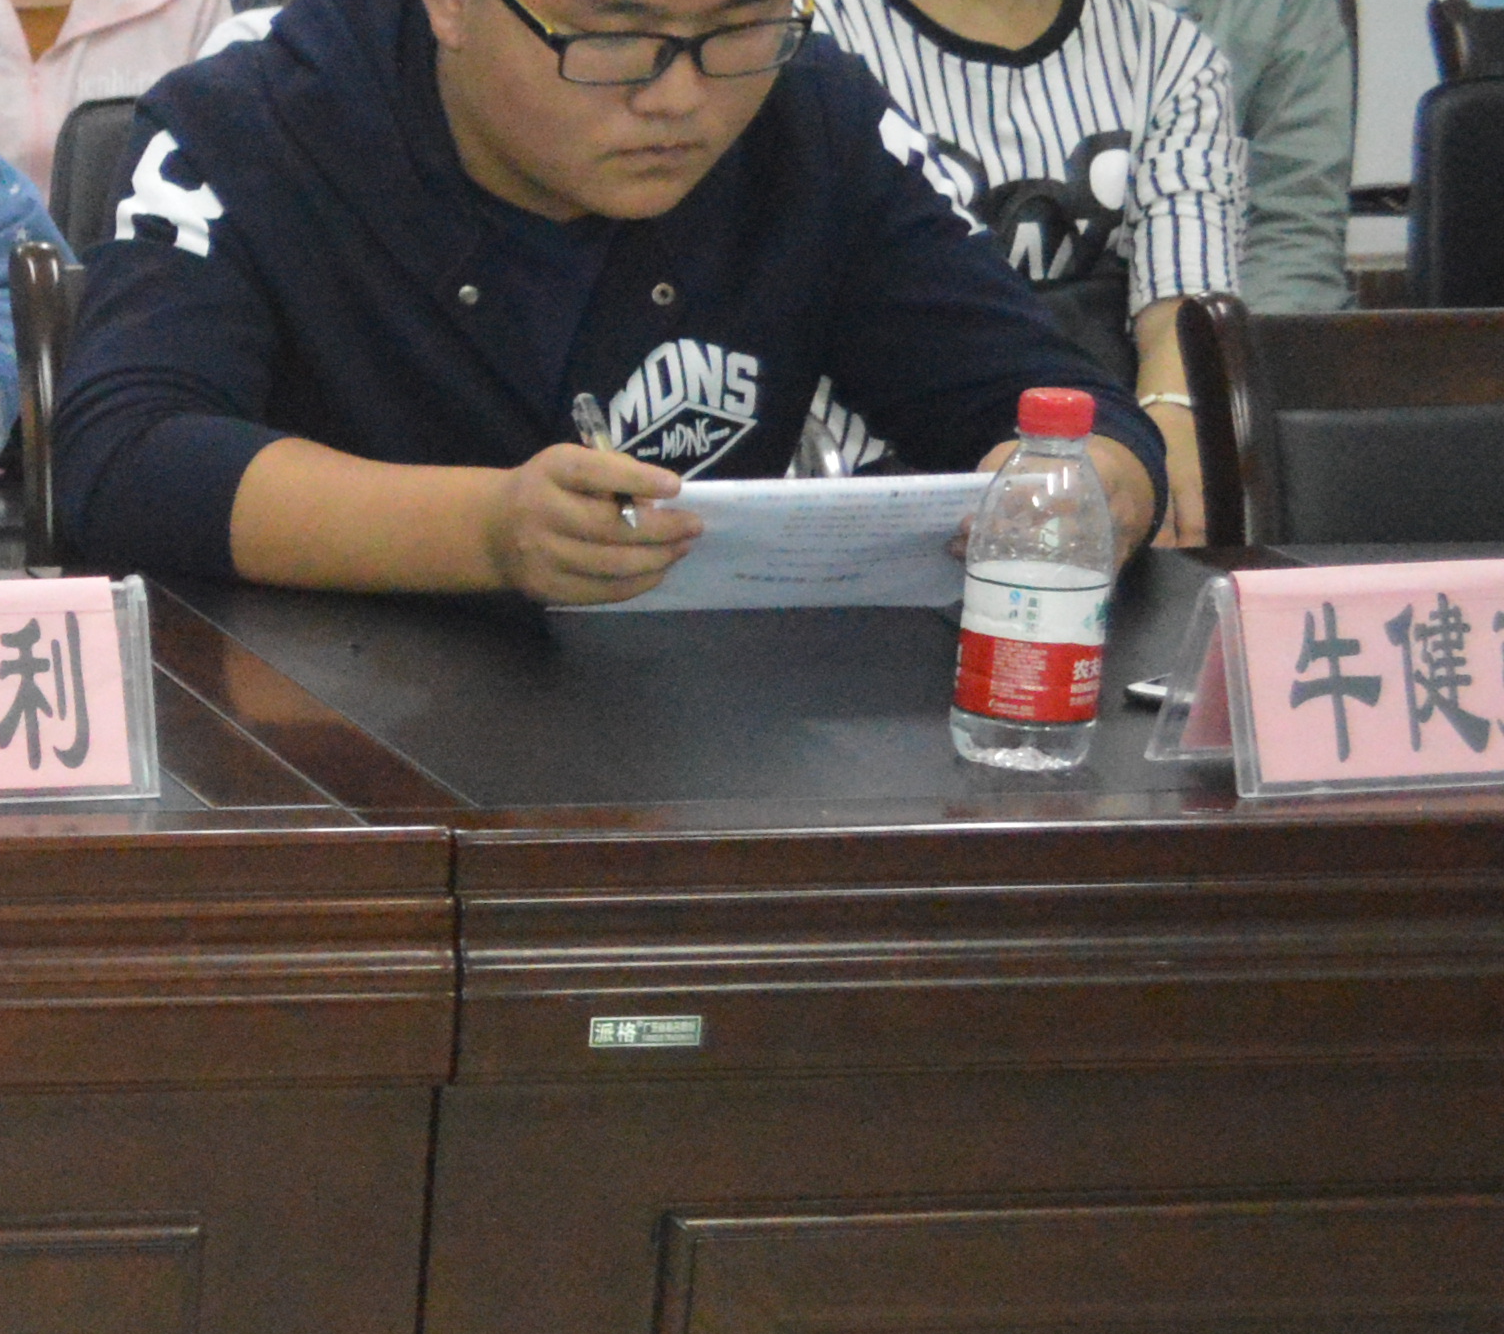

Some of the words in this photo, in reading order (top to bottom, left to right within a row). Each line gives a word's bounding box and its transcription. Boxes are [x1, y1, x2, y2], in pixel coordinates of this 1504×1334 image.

[608, 337, 759, 447] MDNS
[661, 418, 710, 460] MDNS
[1290, 591, 1504, 763] 牛健
